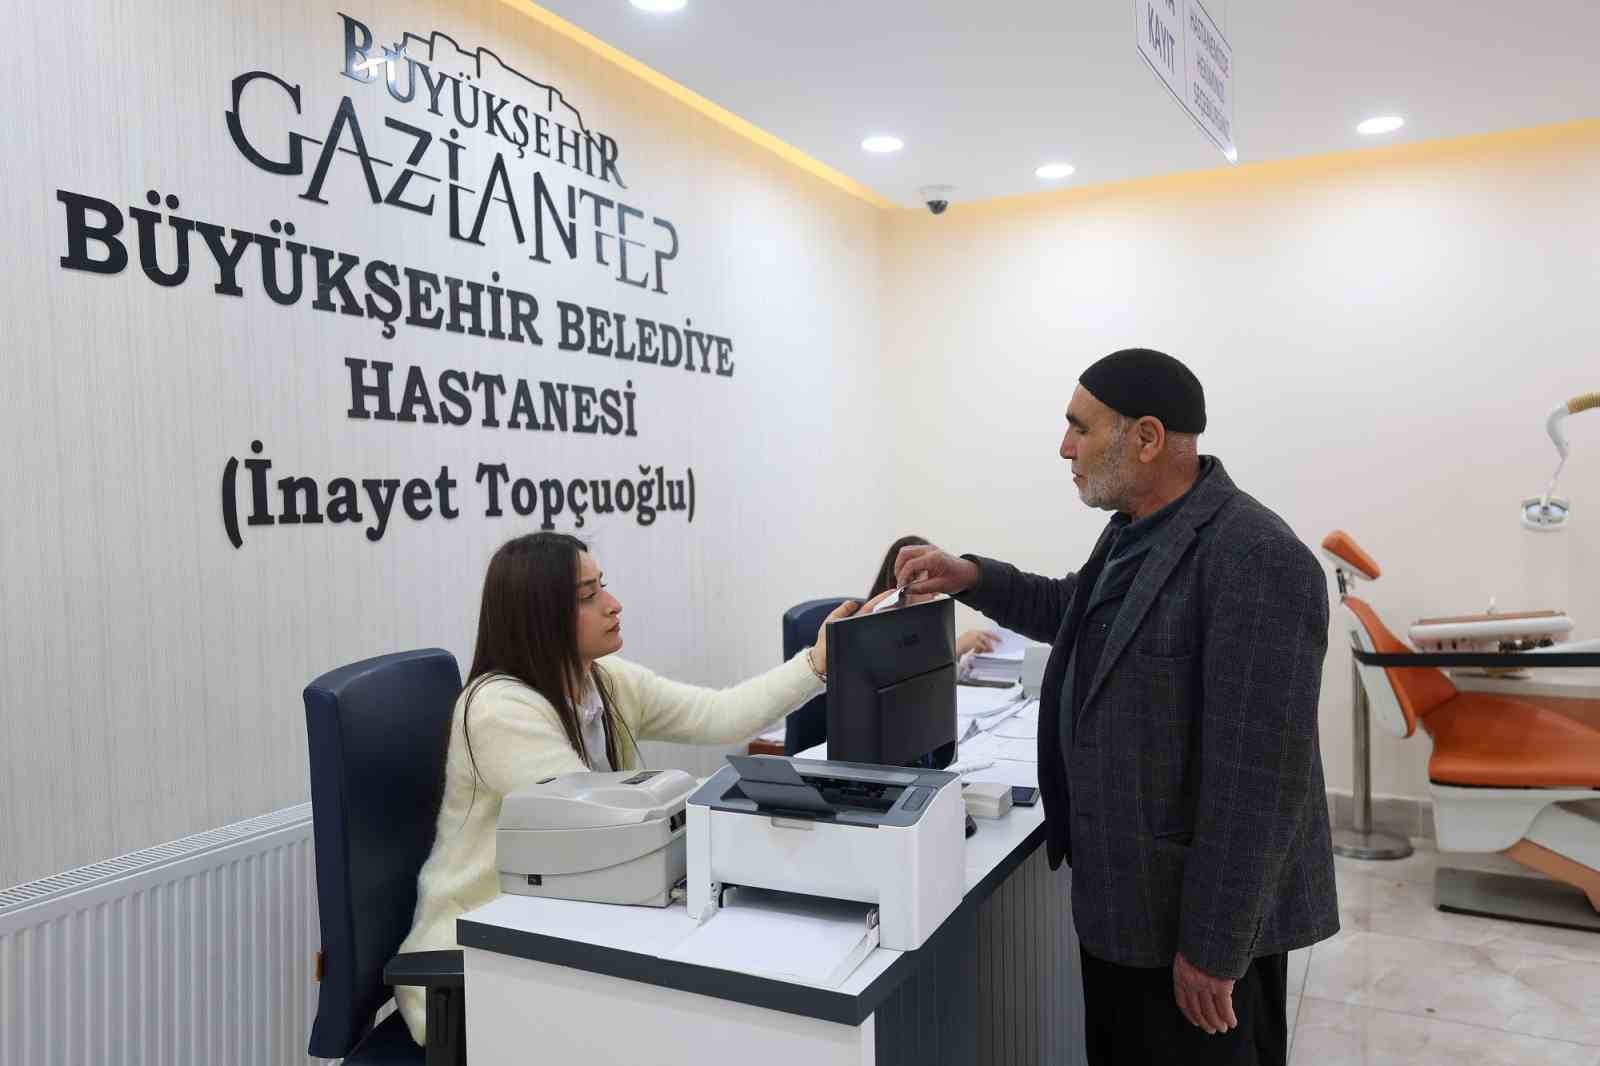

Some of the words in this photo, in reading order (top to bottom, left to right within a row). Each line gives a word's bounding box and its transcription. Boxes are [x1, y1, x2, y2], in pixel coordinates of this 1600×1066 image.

[336, 12, 627, 189] BÜYÜKŞEHİR
[1147, 2, 1175, 74] KAYIT
[225, 71, 679, 294] GAZİANTEP
[57, 190, 543, 346] BÜYÜKŞEHİR
[556, 301, 735, 377] BELEDİYE
[345, 357, 638, 437] HASTANESİ
[222, 440, 459, 549] (İnayet
[475, 463, 696, 530] Topçuoğlu)
